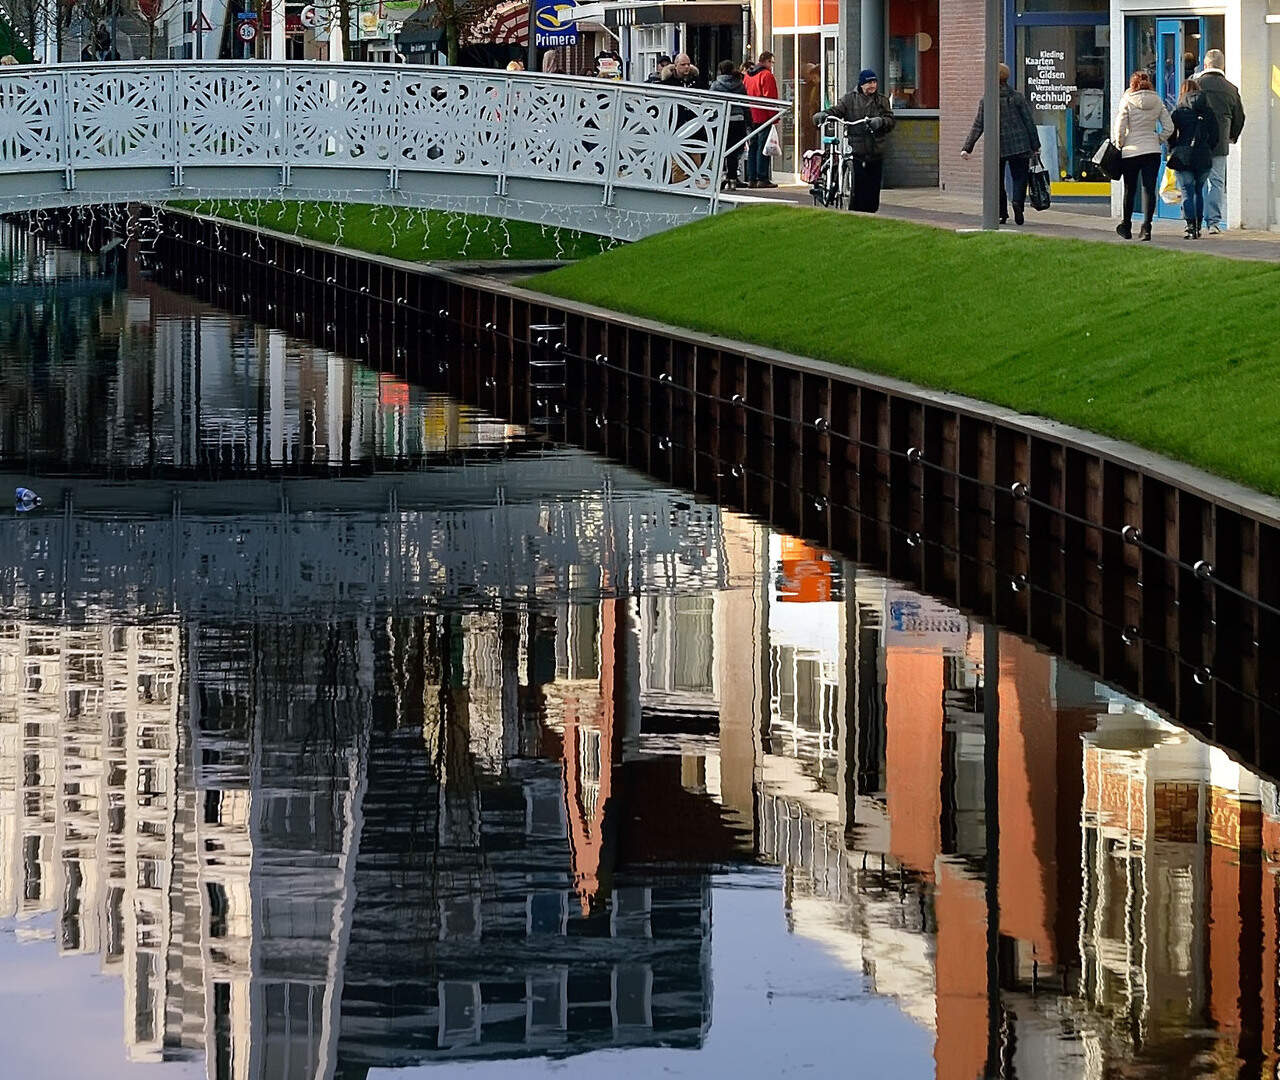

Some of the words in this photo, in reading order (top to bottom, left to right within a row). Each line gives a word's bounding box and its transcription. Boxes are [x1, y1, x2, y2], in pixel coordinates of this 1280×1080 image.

[535, 33, 576, 47] Primera
[1040, 50, 1064, 60] Kleding
[1025, 57, 1054, 65] Kaarten
[1039, 70, 1065, 79] Gidsen
[1035, 84, 1078, 93] Verzekeringen
[1030, 92, 1072, 104] Pechhulp
